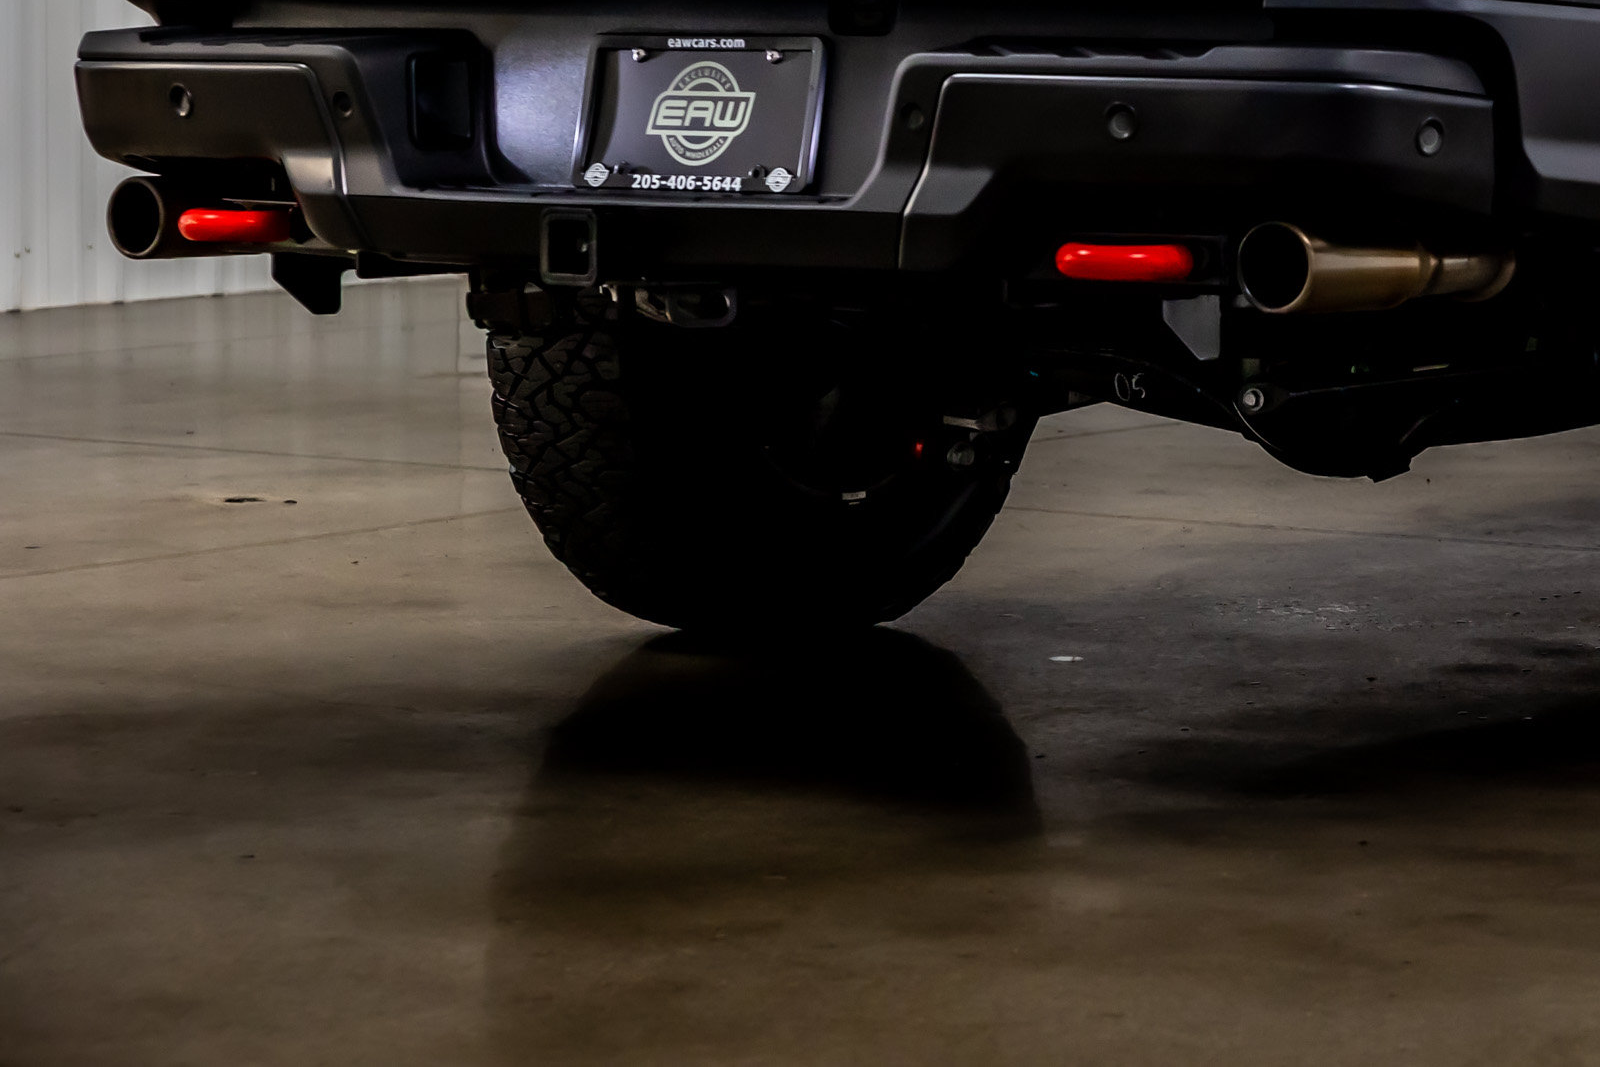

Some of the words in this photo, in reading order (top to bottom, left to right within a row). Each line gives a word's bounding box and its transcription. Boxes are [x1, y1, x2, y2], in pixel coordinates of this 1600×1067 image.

[667, 38, 746, 49] eawcars.com
[655, 99, 747, 128] EAW
[631, 175, 742, 192] 205-406-5644
